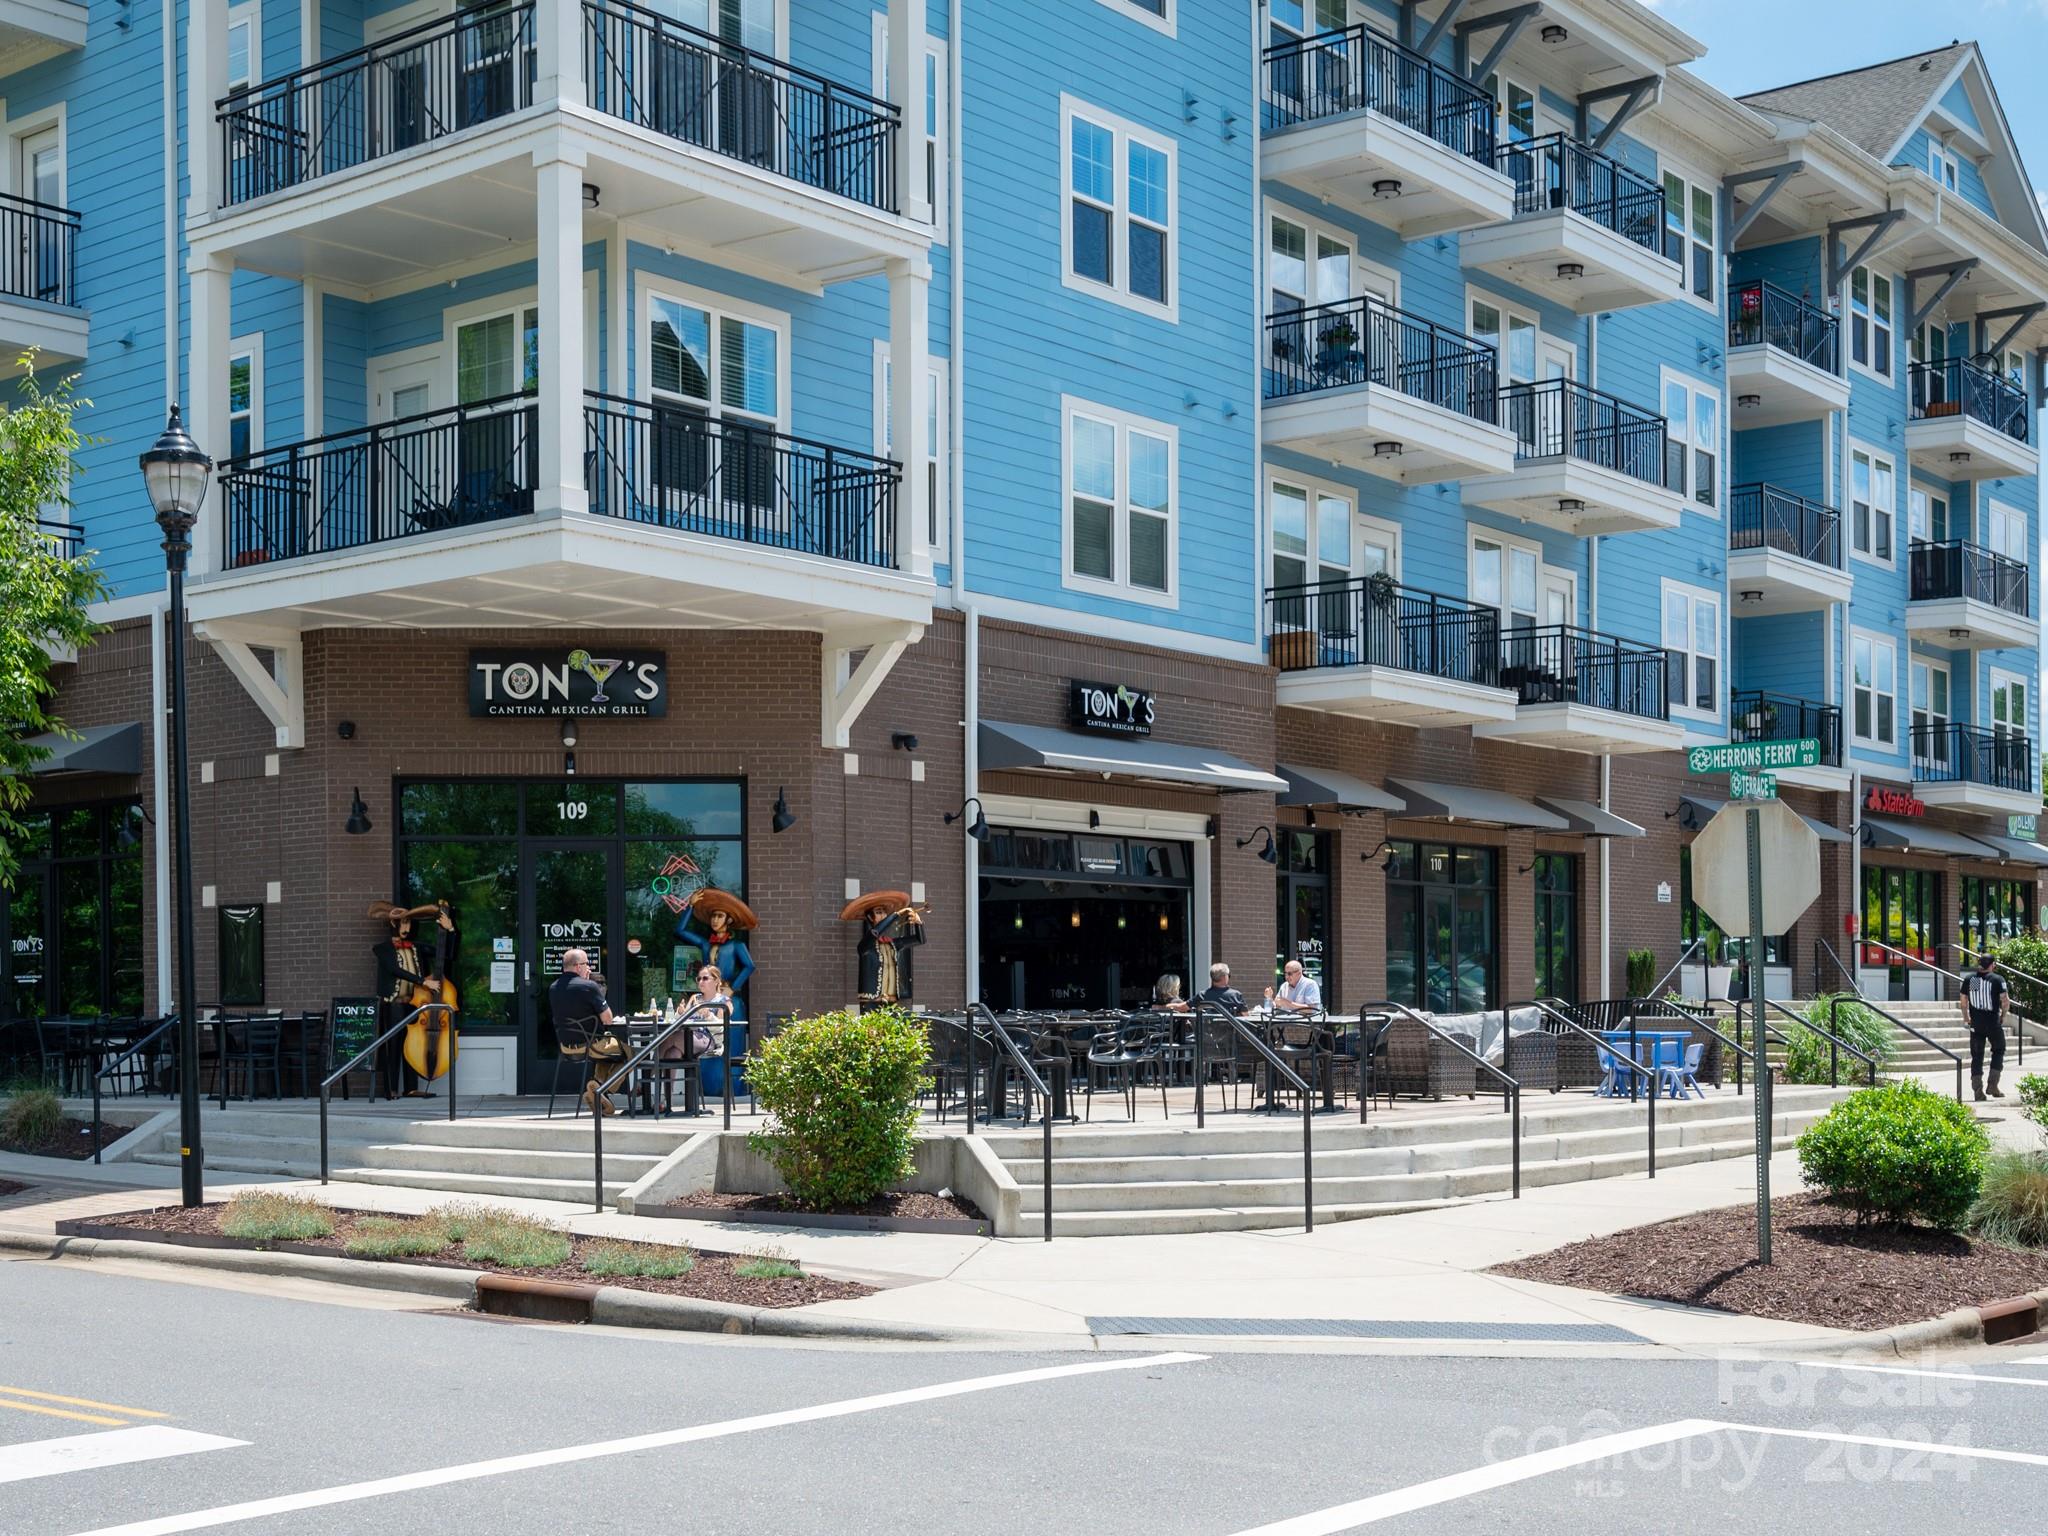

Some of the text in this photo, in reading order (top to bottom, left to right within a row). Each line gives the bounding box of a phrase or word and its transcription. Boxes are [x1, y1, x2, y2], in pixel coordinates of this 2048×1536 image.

[476, 649, 660, 703] TONY'S
[489, 705, 647, 715] CANTINA MEXICAN GRILL
[1081, 684, 1155, 724] TONY'S
[1087, 719, 1150, 734] CANTINA MEXICAN GRILL
[1713, 740, 1815, 769] HERRONS FERRY 600
[1803, 753, 1814, 765] RD
[1741, 775, 1769, 797] TERRACE
[557, 802, 588, 820] 109
[1430, 857, 1442, 871] 110
[541, 918, 602, 938] TONY'S
